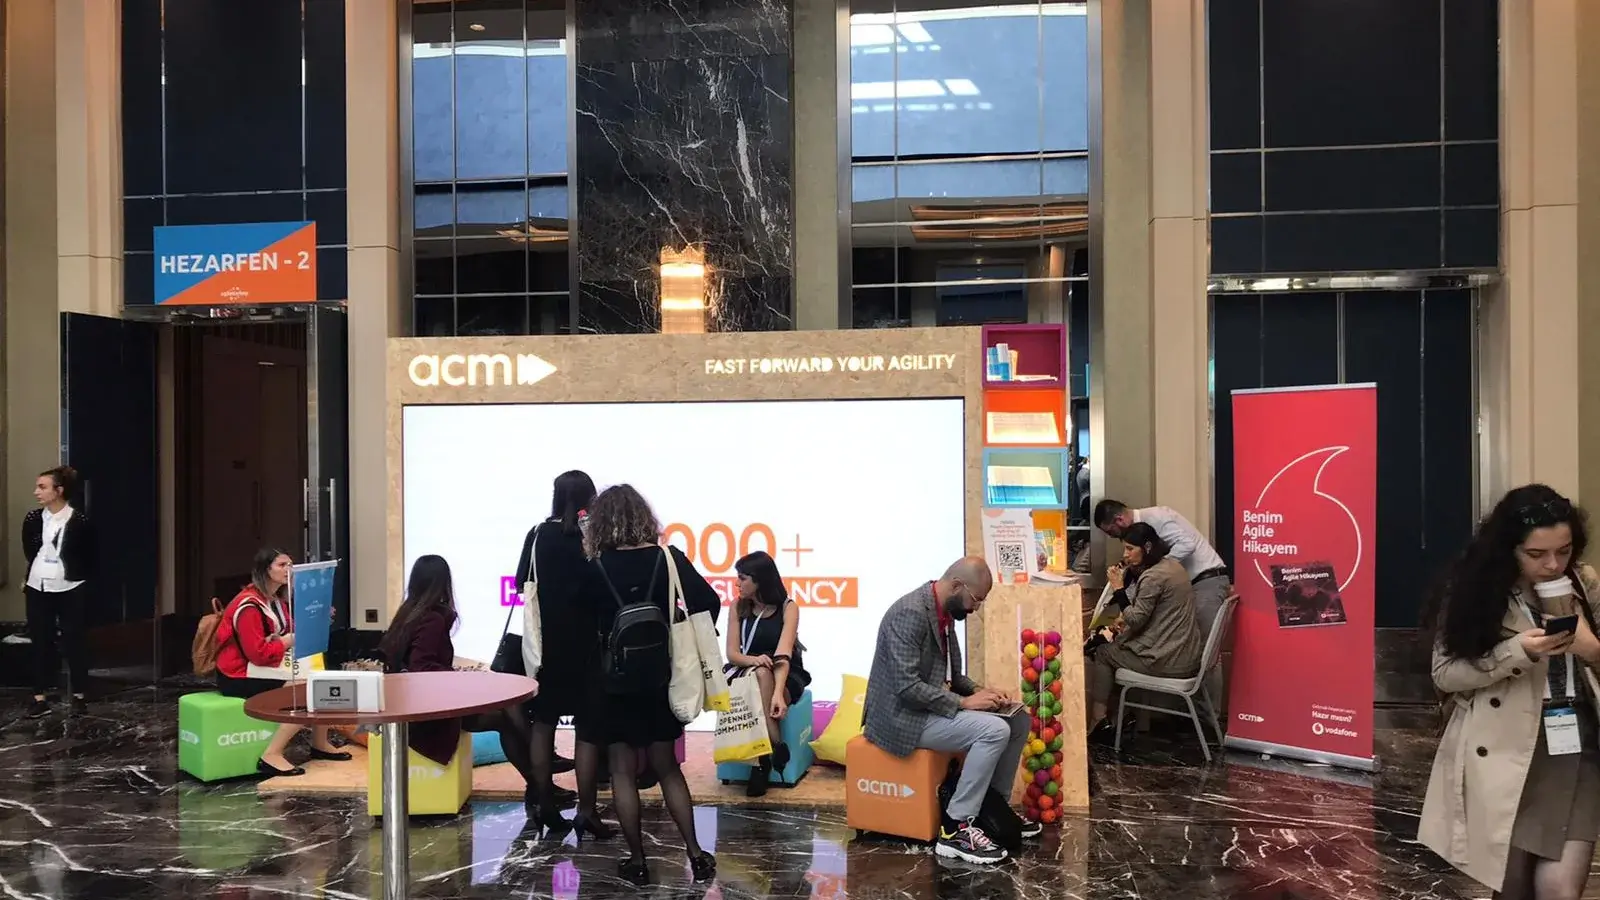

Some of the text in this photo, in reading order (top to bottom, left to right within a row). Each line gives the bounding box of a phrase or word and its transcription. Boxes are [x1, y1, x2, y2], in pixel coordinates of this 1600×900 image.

[161, 252, 278, 273] HEZARFEN
[297, 251, 310, 270] 2
[408, 354, 512, 386] acm
[705, 354, 956, 374] FAST FORWARD YOUR AGILITY
[1243, 510, 1283, 523] Benim
[1243, 524, 1274, 540] Agile
[1243, 540, 1298, 556] Hikayem
[217, 730, 257, 746] acm
[1325, 727, 1358, 738] vodafone
[857, 778, 898, 797] acm
